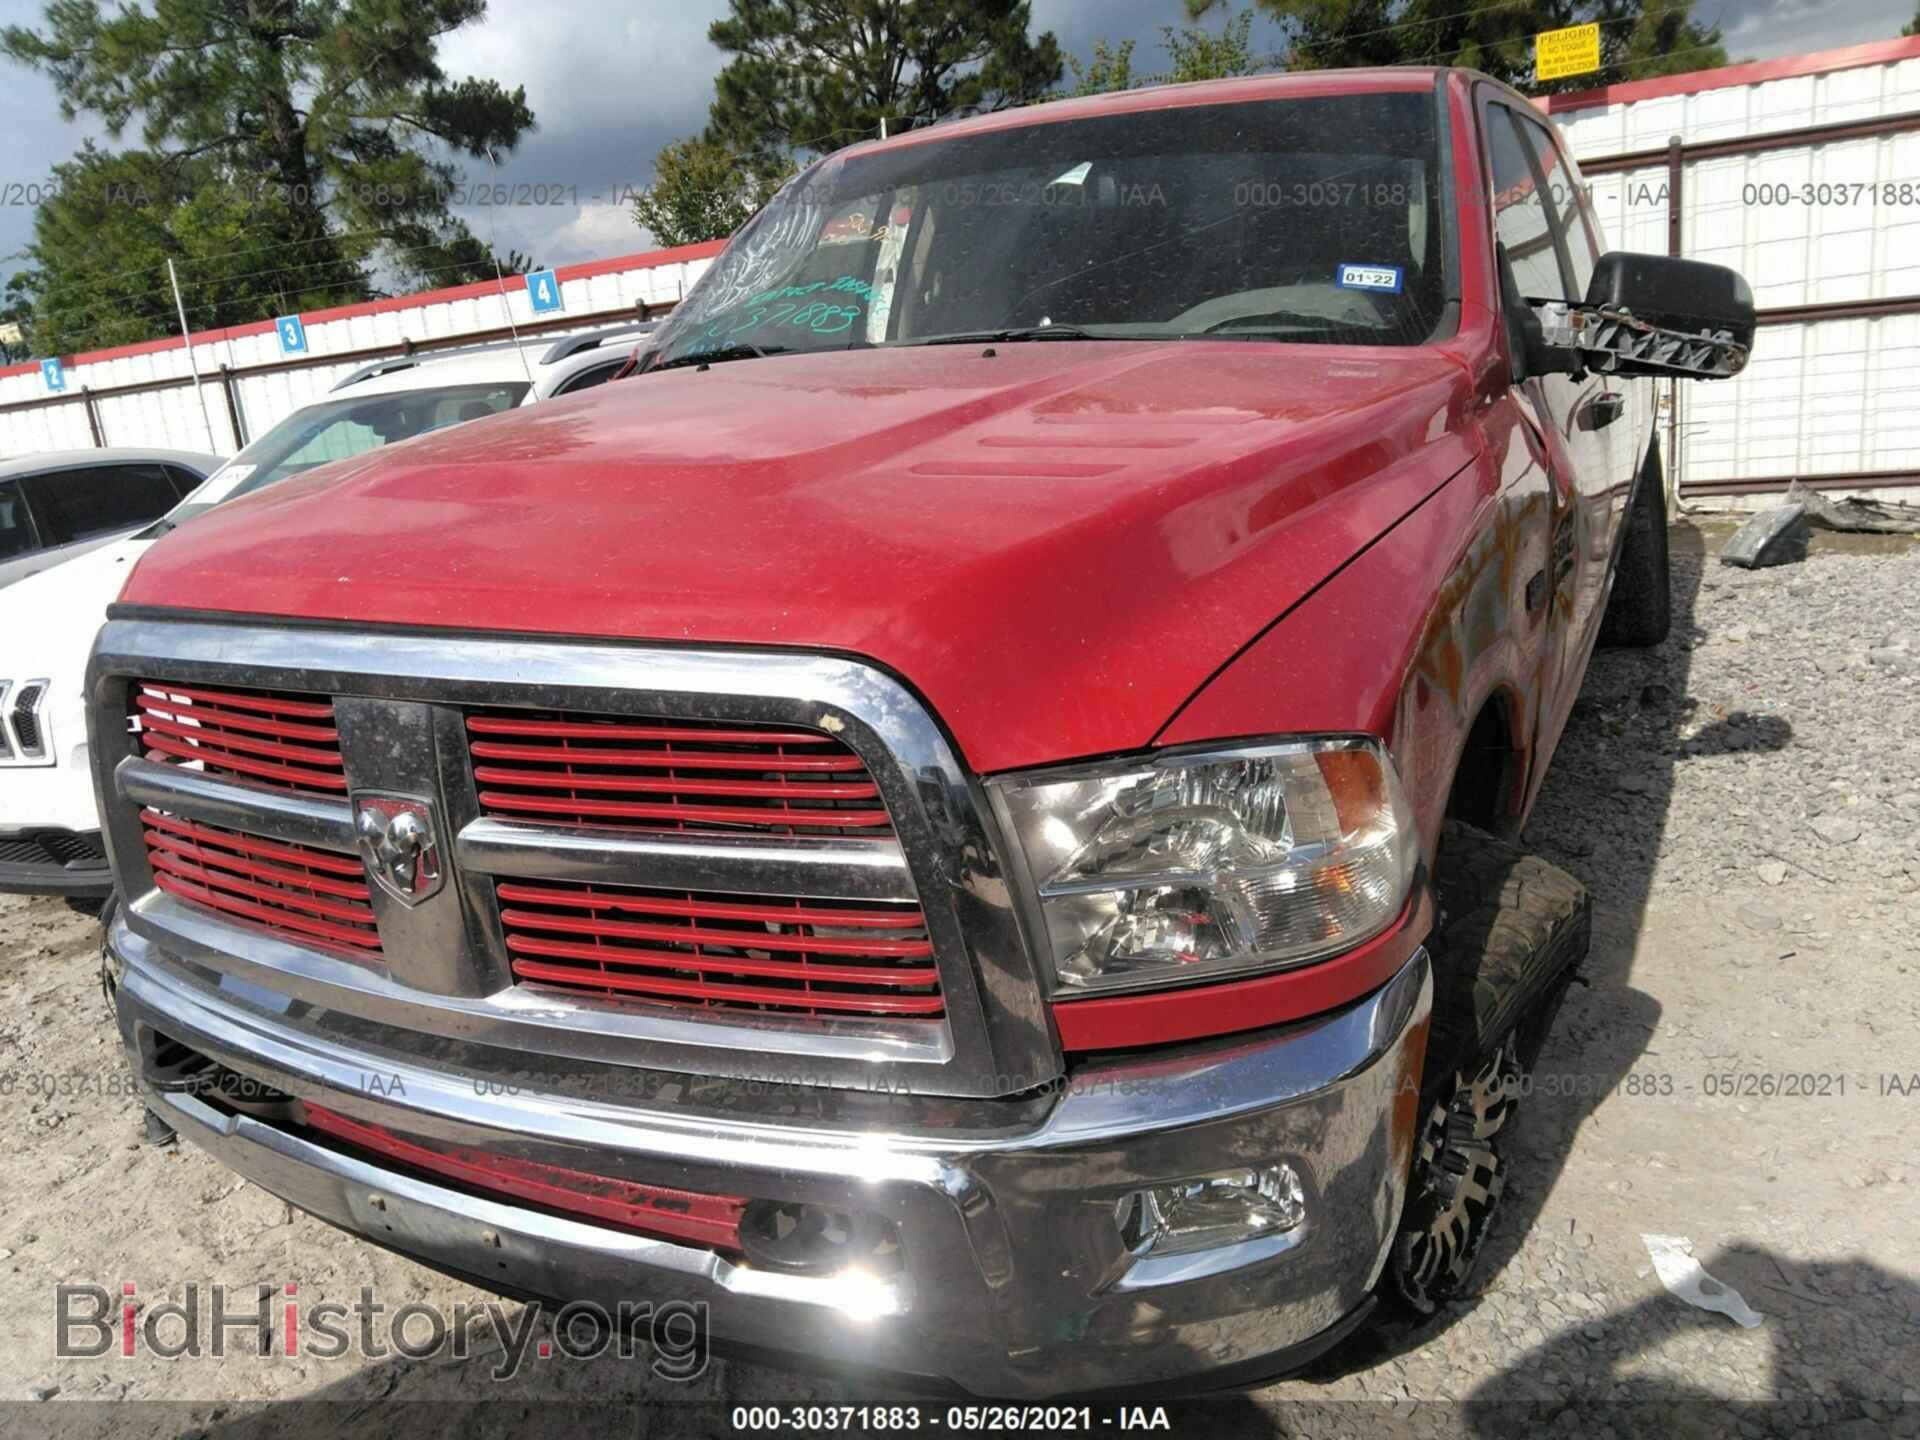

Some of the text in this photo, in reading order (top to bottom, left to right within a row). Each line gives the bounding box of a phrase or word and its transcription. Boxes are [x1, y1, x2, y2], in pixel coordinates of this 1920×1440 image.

[1540, 26, 1596, 45] PELIGRO
[538, 279, 551, 305] 4
[285, 323, 298, 346] 3
[50, 364, 60, 385] 2
